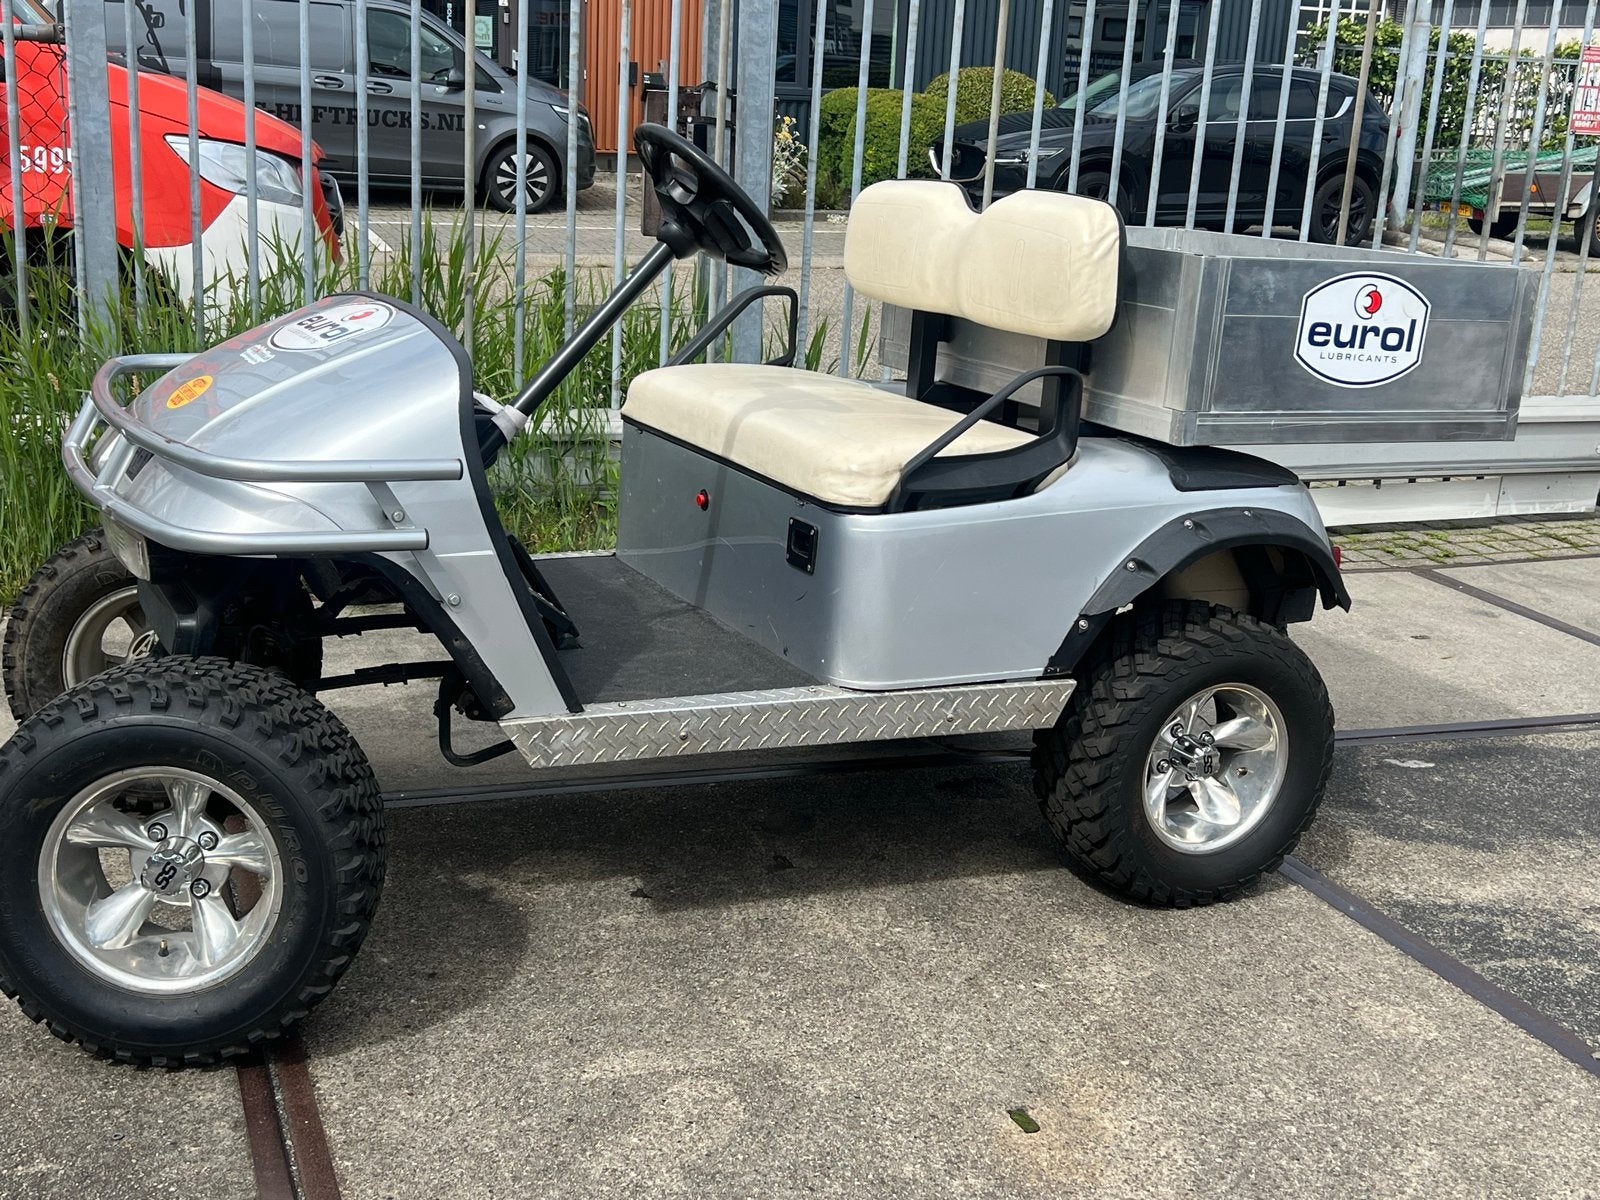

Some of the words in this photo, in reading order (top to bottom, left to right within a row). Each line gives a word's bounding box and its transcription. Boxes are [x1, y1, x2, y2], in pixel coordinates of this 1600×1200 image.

[296, 315, 364, 342] eurol
[1307, 318, 1417, 352] eurol
[1319, 351, 1398, 364] LUBRICANTS
